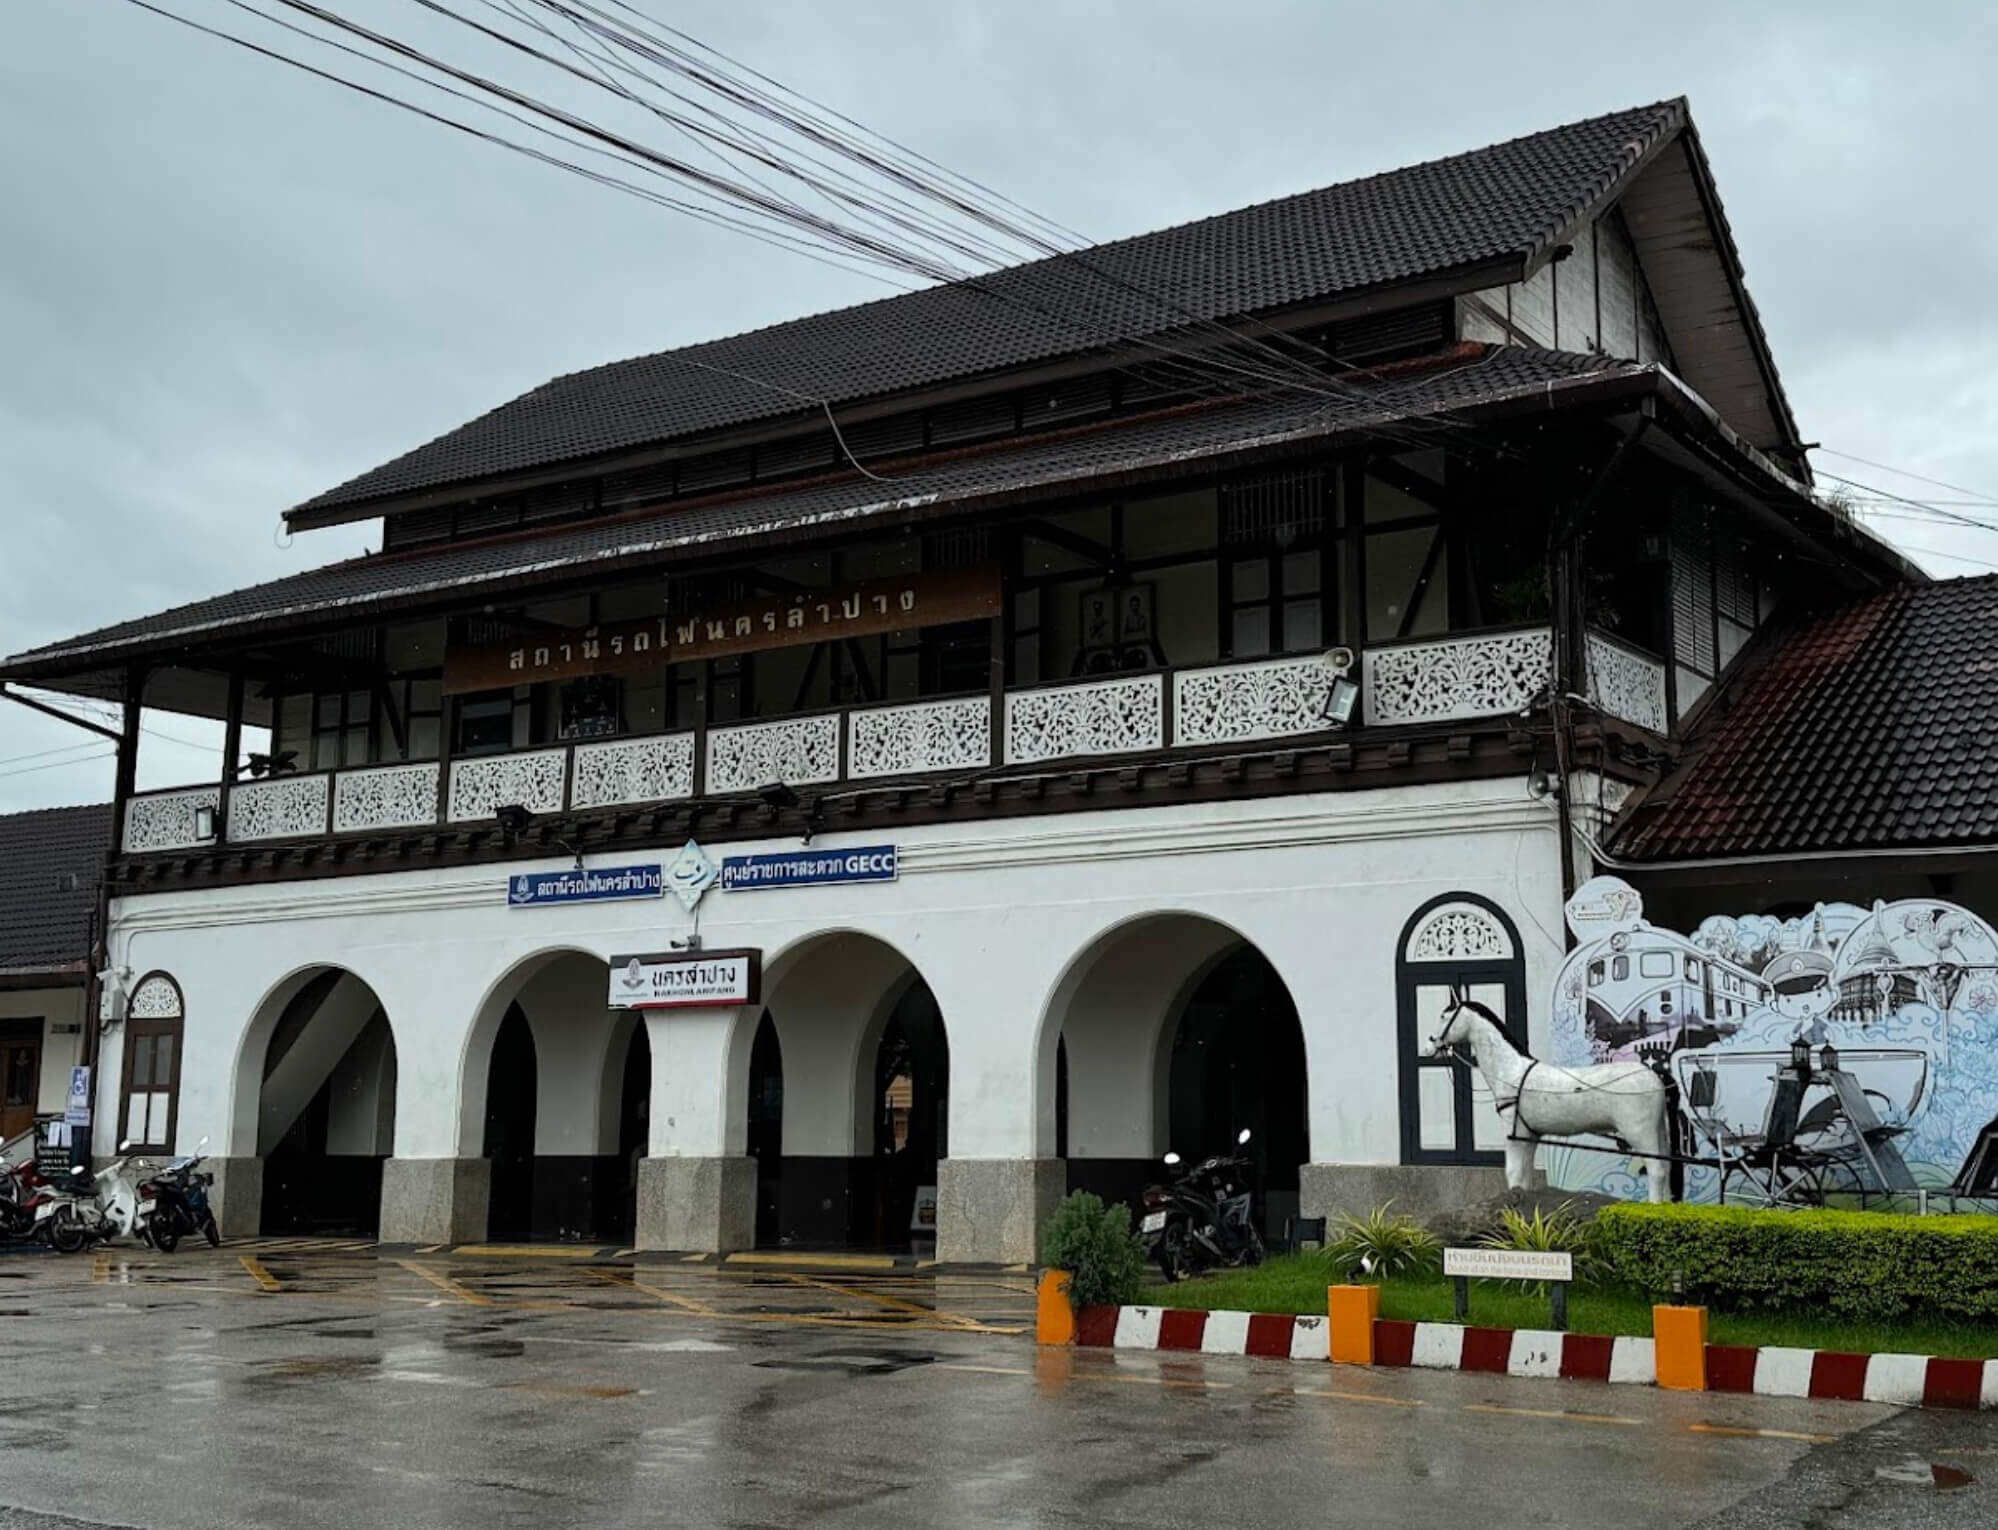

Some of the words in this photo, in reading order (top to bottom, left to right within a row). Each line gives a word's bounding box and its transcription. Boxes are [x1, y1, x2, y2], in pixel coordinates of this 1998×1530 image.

[508, 589, 916, 671] สถานีรถไฟนครลำปาง
[537, 870, 660, 896] สถานีรถไฟนครลำปาง
[723, 858, 843, 888] ศูนย์ราชการสะดวก
[845, 854, 894, 873] GECC
[652, 963, 736, 987] นครลำปาง
